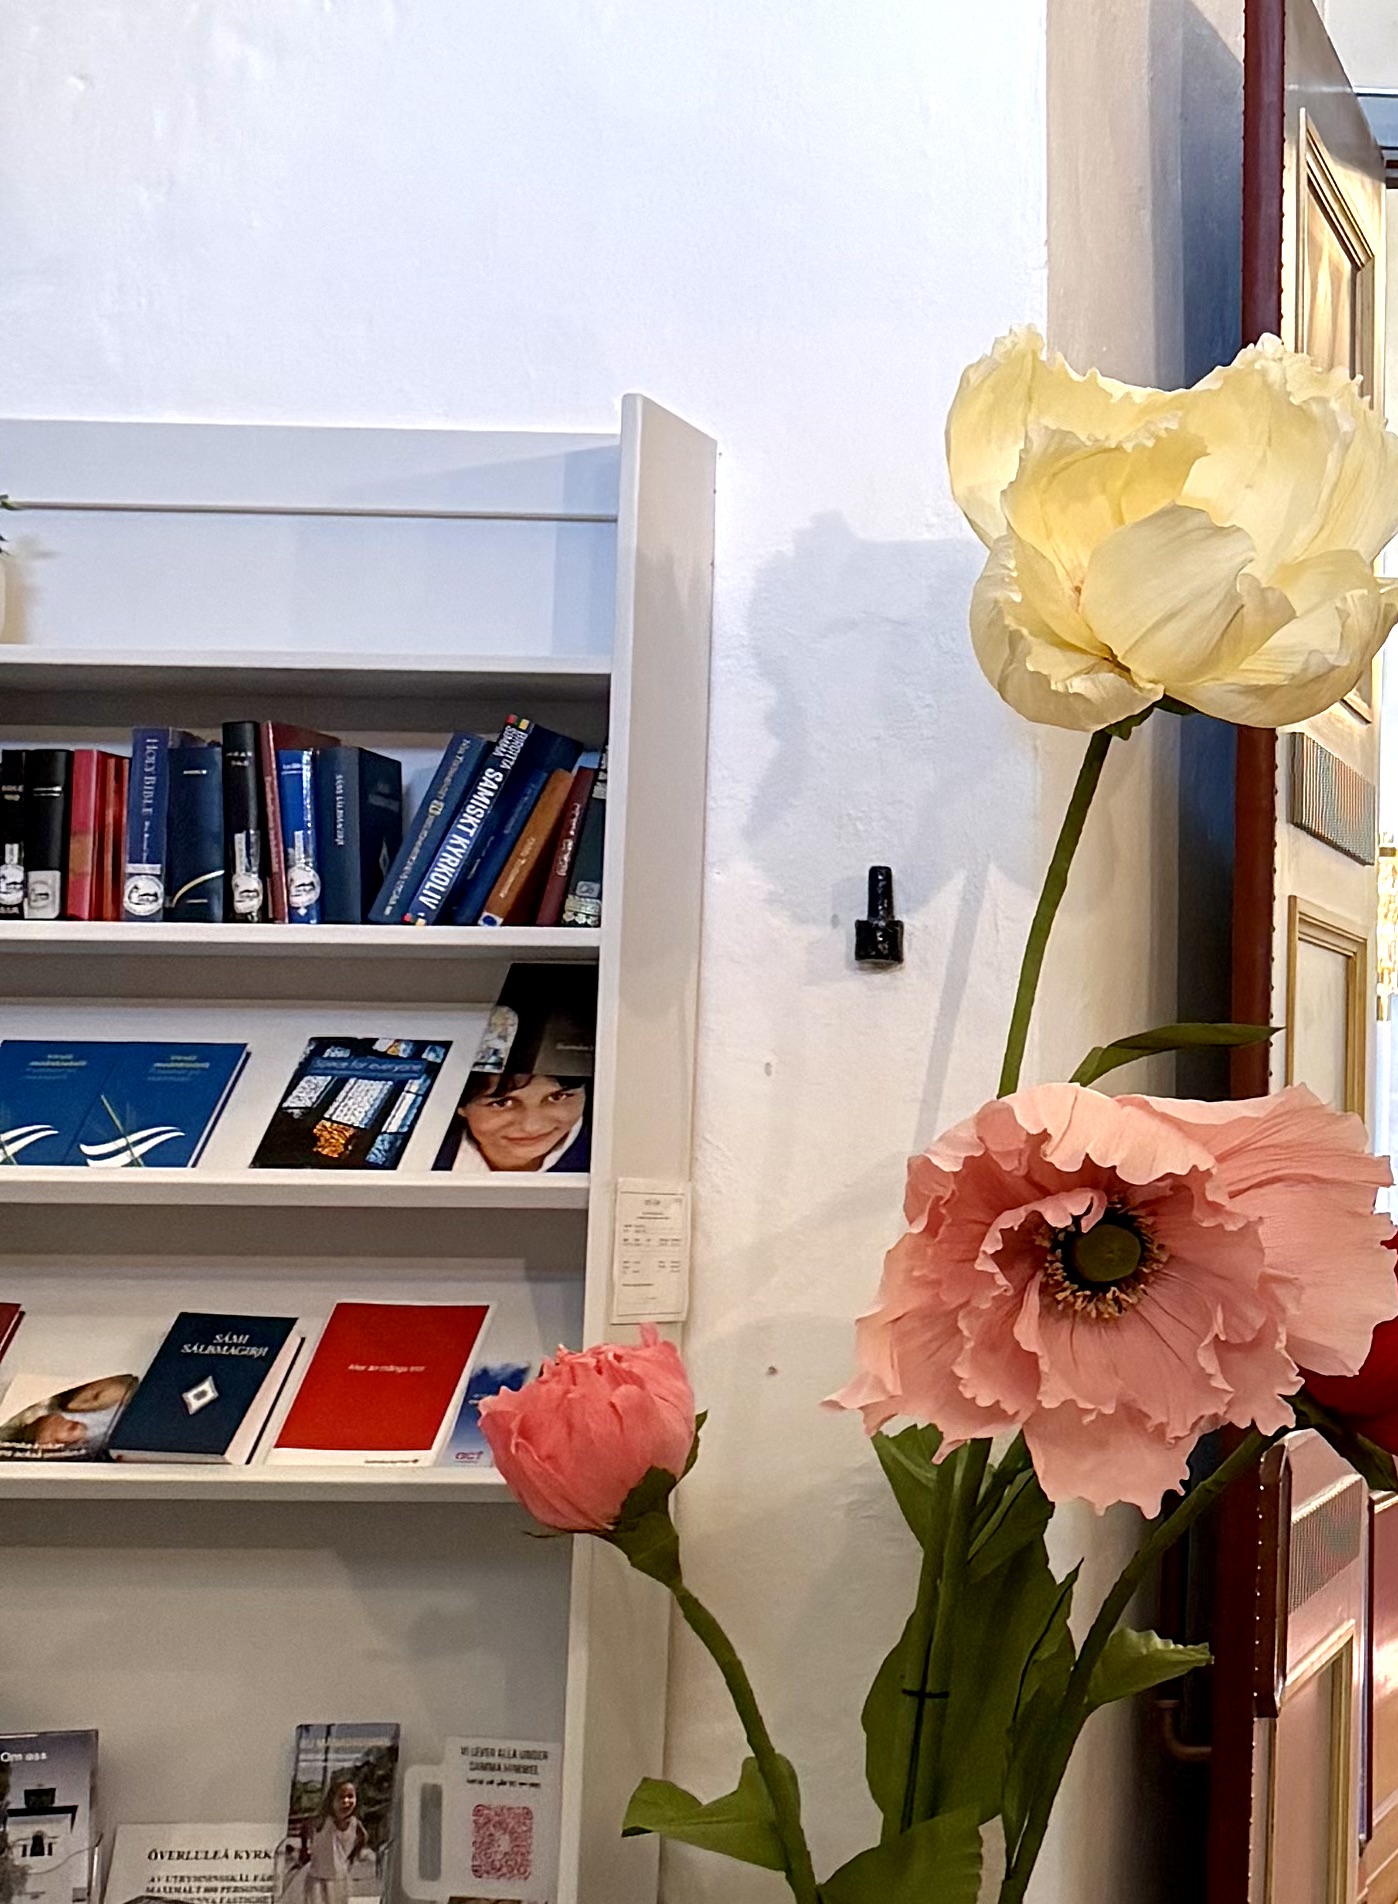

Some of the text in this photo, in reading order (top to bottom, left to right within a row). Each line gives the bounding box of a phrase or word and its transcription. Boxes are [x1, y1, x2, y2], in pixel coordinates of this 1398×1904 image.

[144, 738, 159, 772] HOLY
[142, 776, 156, 815] BIBLE
[457, 767, 504, 837] SAMISKT
[418, 834, 471, 910] KYRKOLIV
[0, 1752, 23, 1762] Om
[147, 1848, 273, 1861] ÖVERLULEÅ KYRK
